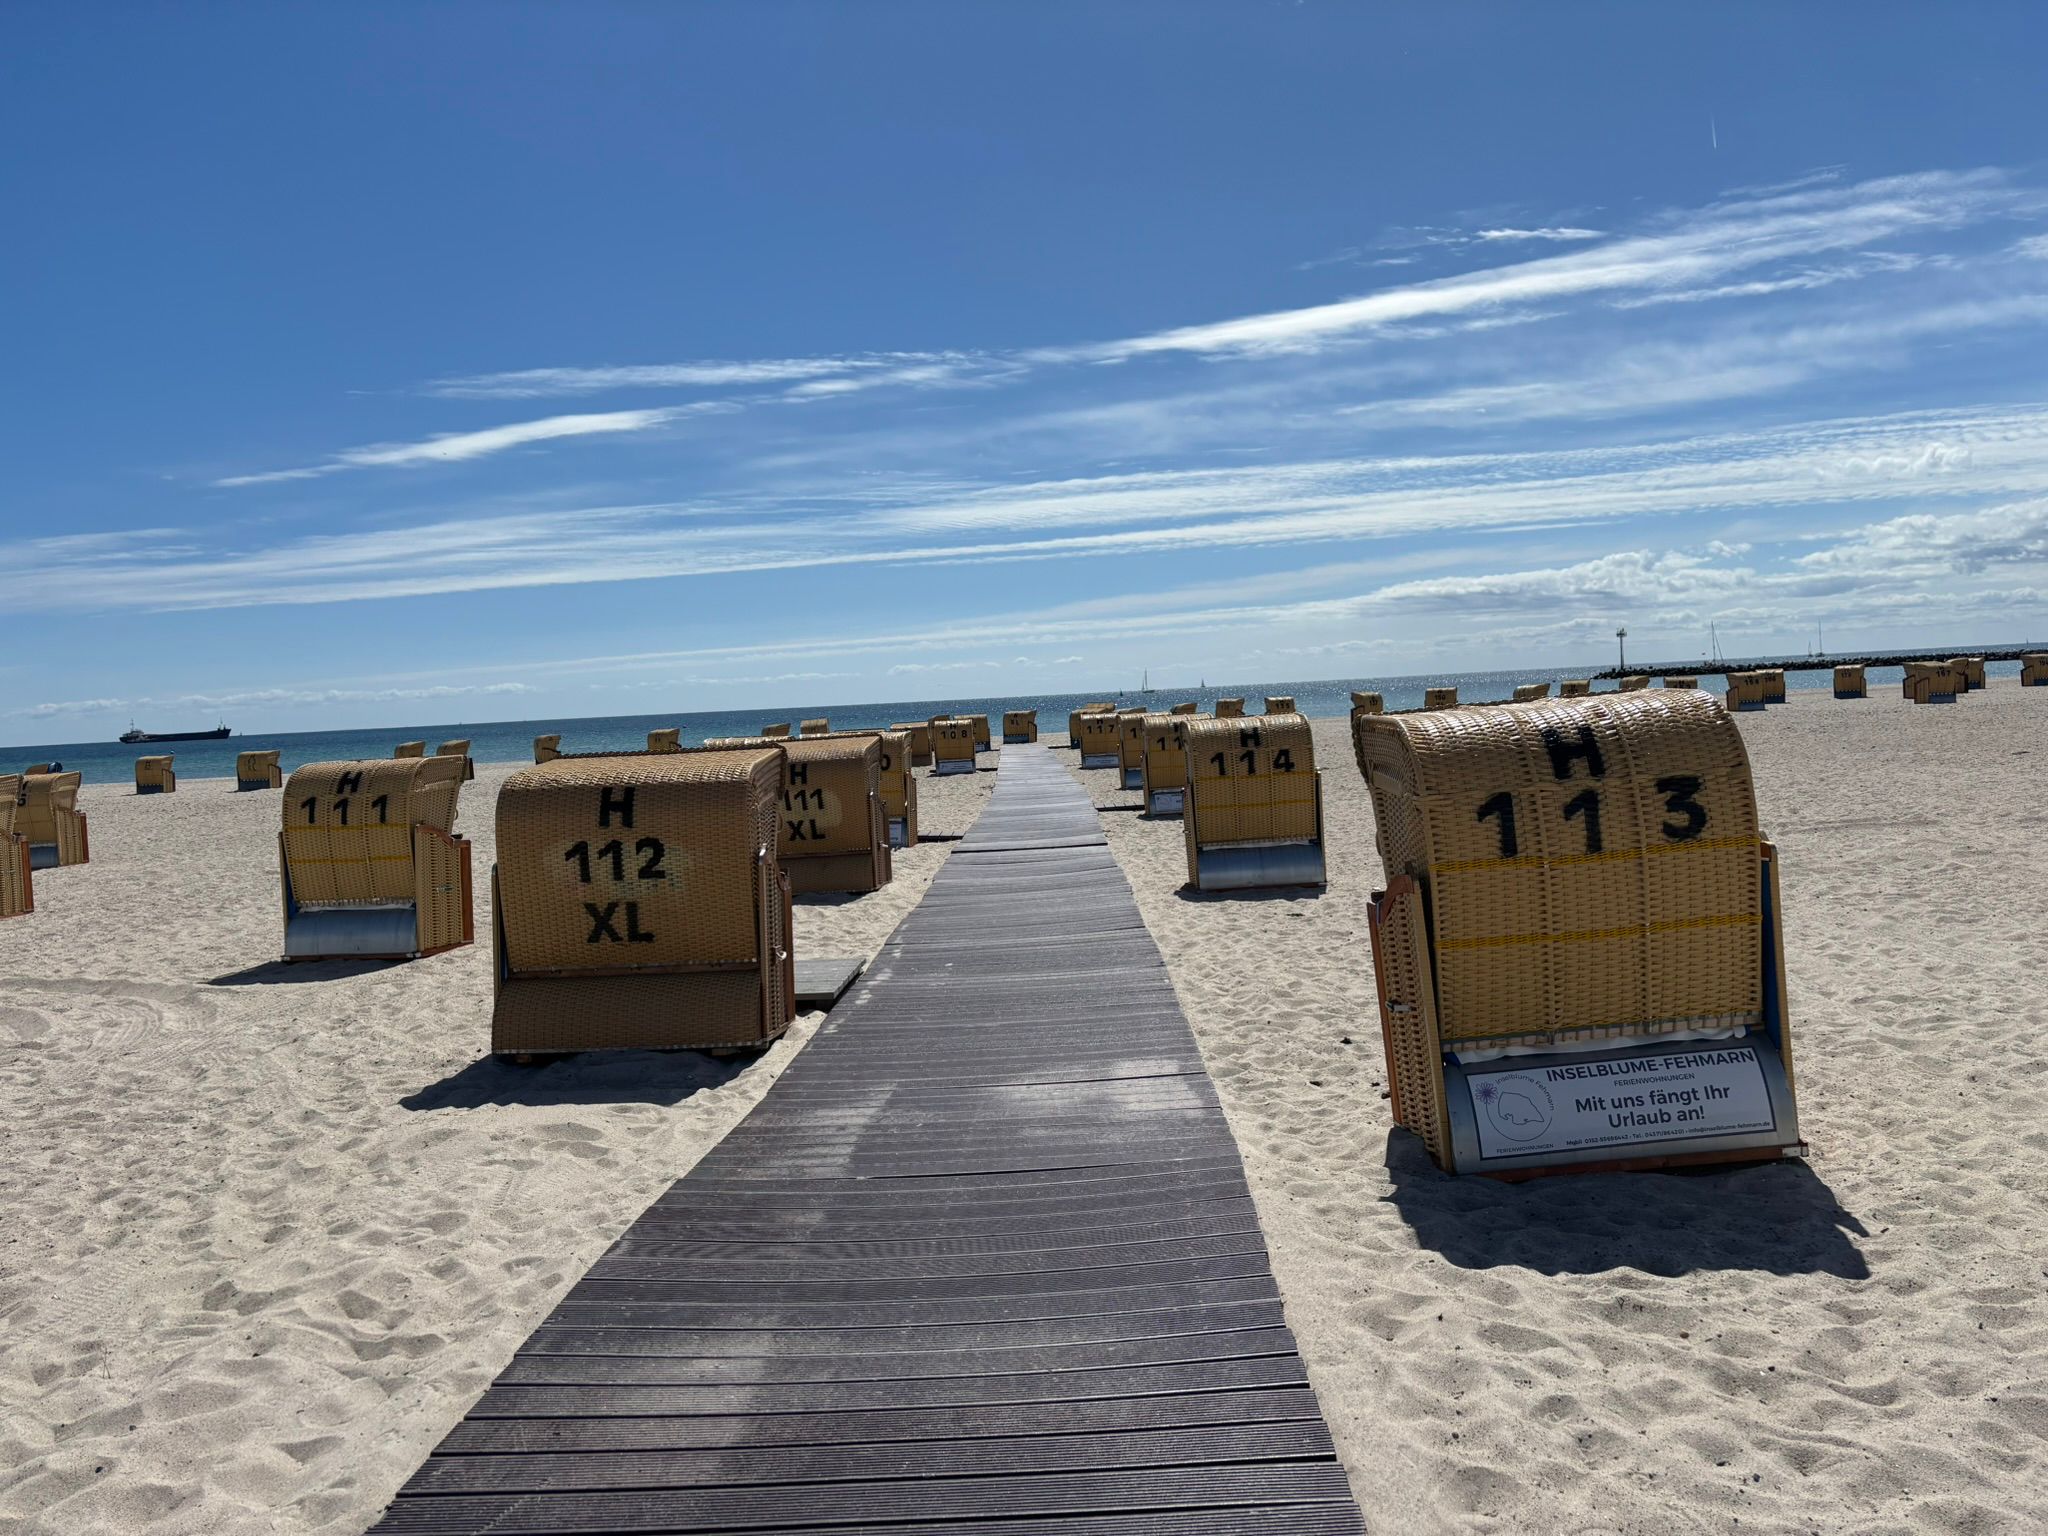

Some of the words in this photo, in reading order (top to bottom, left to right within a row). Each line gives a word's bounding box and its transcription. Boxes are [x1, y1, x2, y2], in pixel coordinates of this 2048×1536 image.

[941, 730, 968, 740] 108
[1087, 724, 1115, 734] 117
[1240, 727, 1262, 749] H
[1210, 749, 1295, 776] 114
[1541, 725, 1606, 781] H
[337, 771, 363, 794] H
[790, 763, 808, 786] H
[301, 795, 388, 825] 111
[598, 787, 636, 828] H
[784, 788, 824, 811] 111
[1477, 776, 1707, 858] 113
[786, 820, 826, 841] XL
[565, 837, 666, 883] 112
[584, 902, 655, 943] XL
[1546, 1050, 1755, 1082] INSELBLUME-FEHMARN
[1495, 1073, 1535, 1084] Inselblume
[1535, 1080, 1555, 1111] Fehmarn
[1613, 1073, 1695, 1087] FERIENWOHNUNGEN
[1575, 1096, 1607, 1112] Mit
[1610, 1095, 1645, 1109] uns
[1649, 1088, 1700, 1106] fängt
[1703, 1085, 1730, 1099] Ihr
[1608, 1109, 1671, 1128] Urlaub
[1676, 1105, 1705, 1122] an!
[1496, 1143, 1554, 1154] FERIENWOHNUNGEN
